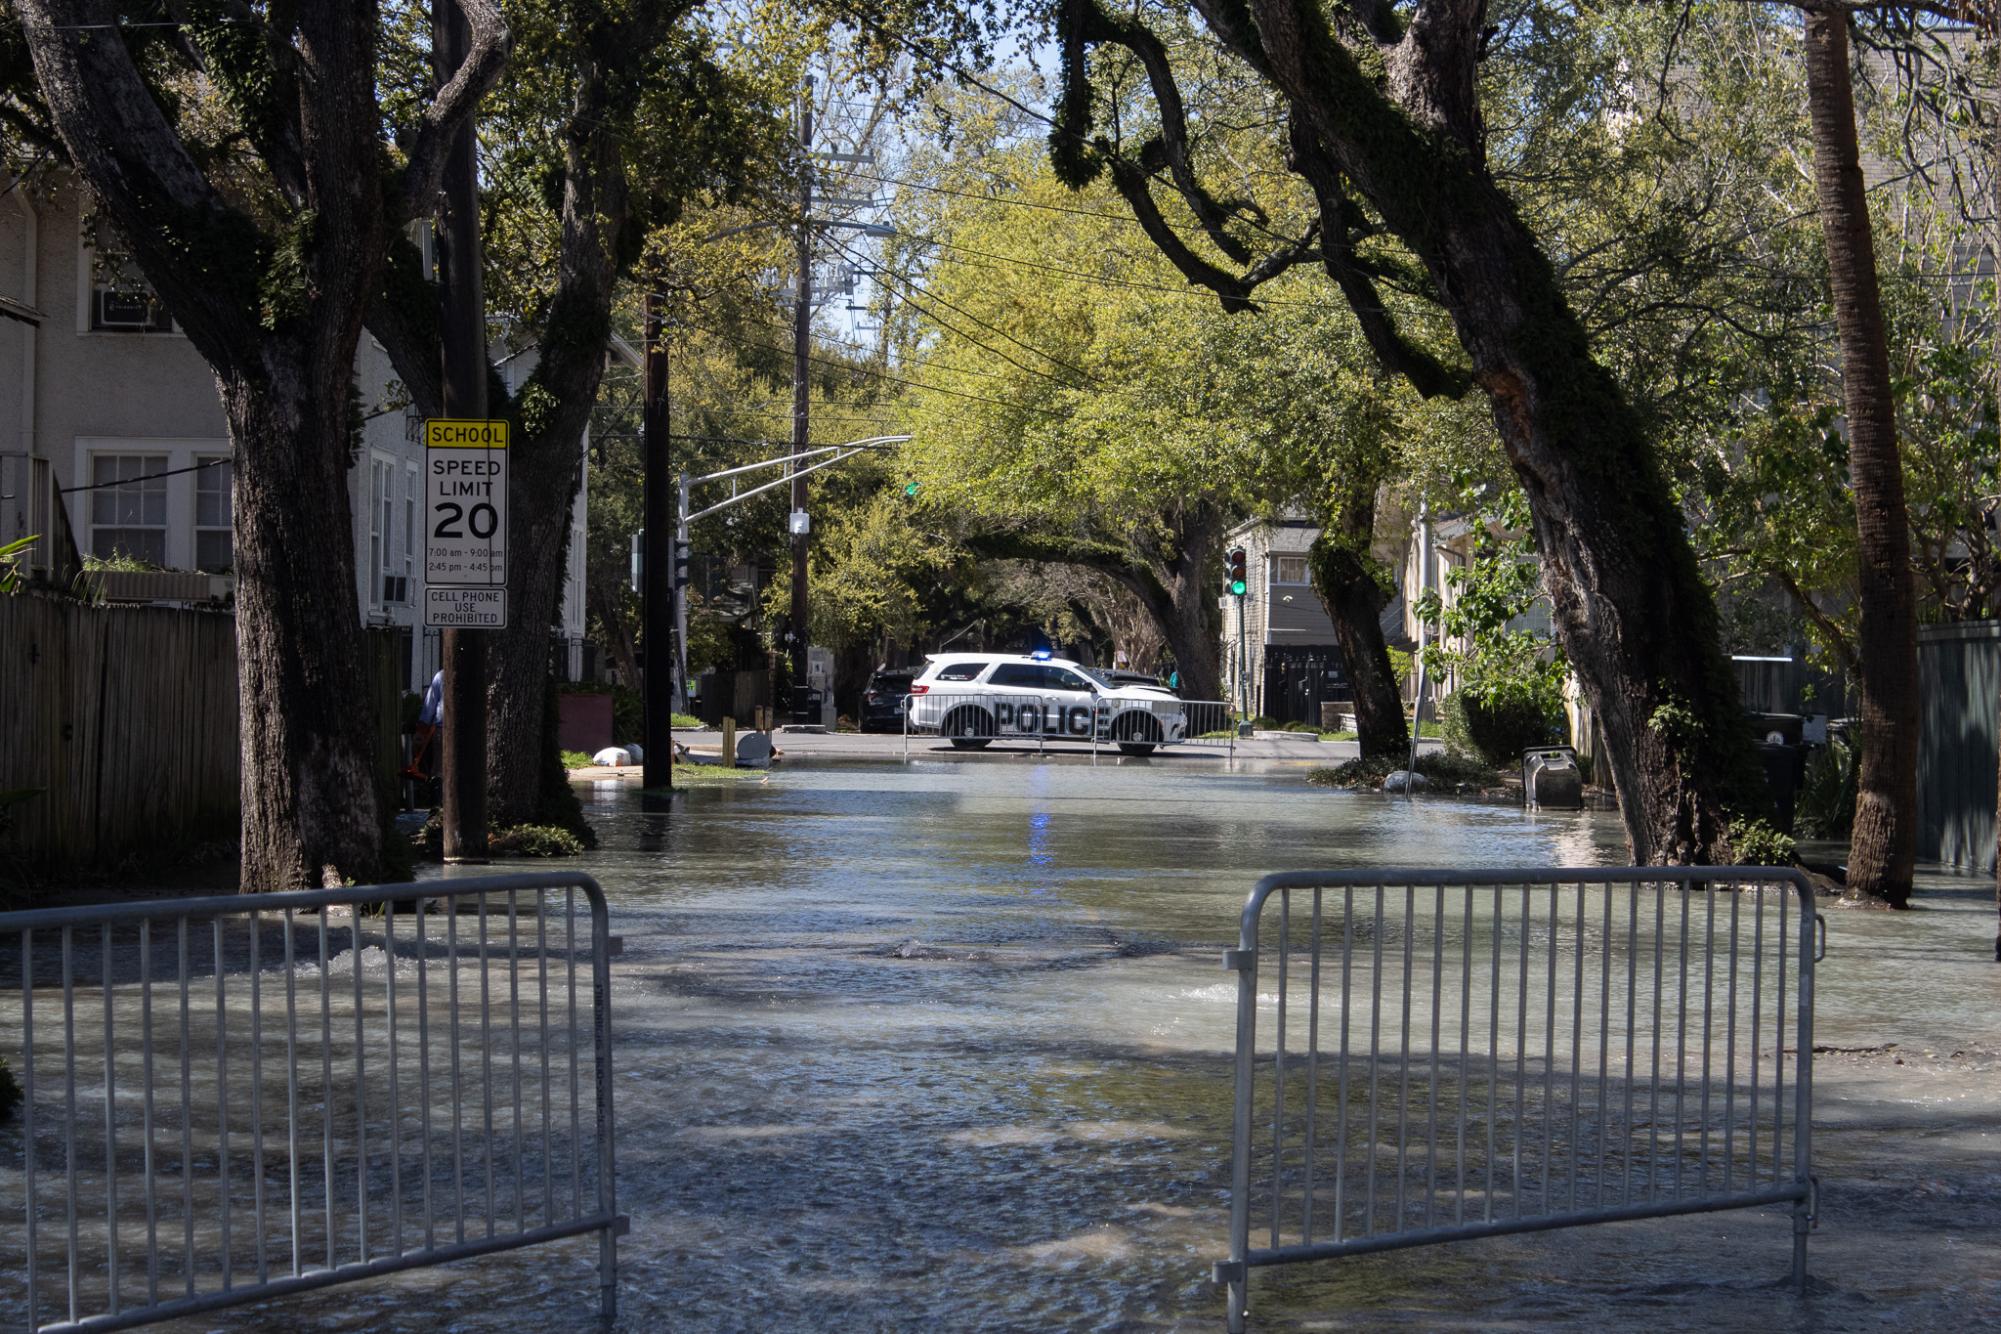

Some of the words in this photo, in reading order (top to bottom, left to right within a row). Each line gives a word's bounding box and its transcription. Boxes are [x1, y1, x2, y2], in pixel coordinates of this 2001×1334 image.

[432, 427, 504, 443] SCHOOL
[433, 460, 501, 475] SPEED
[440, 481, 493, 496] LIMIT
[434, 502, 498, 539] 20
[429, 548, 447, 557] 7:00
[470, 548, 488, 557] 9:00
[429, 562, 447, 571] 2:45
[449, 564, 462, 572] pm
[470, 563, 488, 571] 4:45
[431, 591, 459, 602] CELL
[462, 592, 500, 602] PHONE
[455, 602, 476, 613] USE
[433, 613, 497, 623] PROHIBITED
[994, 702, 1111, 739] POLICE
